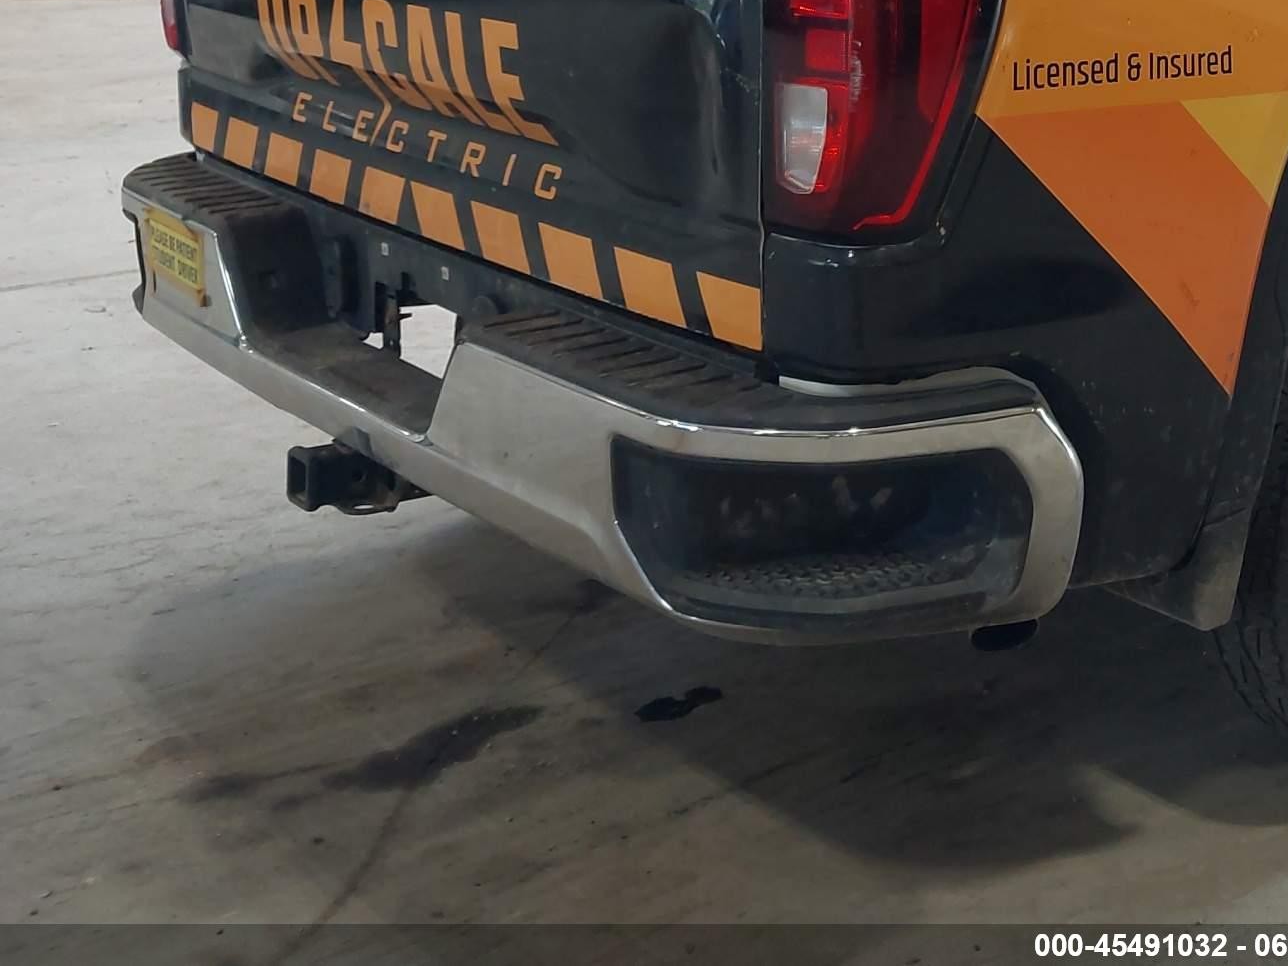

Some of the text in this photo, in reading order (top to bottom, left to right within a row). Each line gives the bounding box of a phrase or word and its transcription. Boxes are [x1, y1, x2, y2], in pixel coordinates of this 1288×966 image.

[1013, 45, 1233, 91] Licensed & Insured
[292, 92, 562, 201] ELECTRIC
[168, 235, 176, 251] BE
[176, 239, 198, 261] PATIENT
[177, 259, 198, 284] DRIVER
